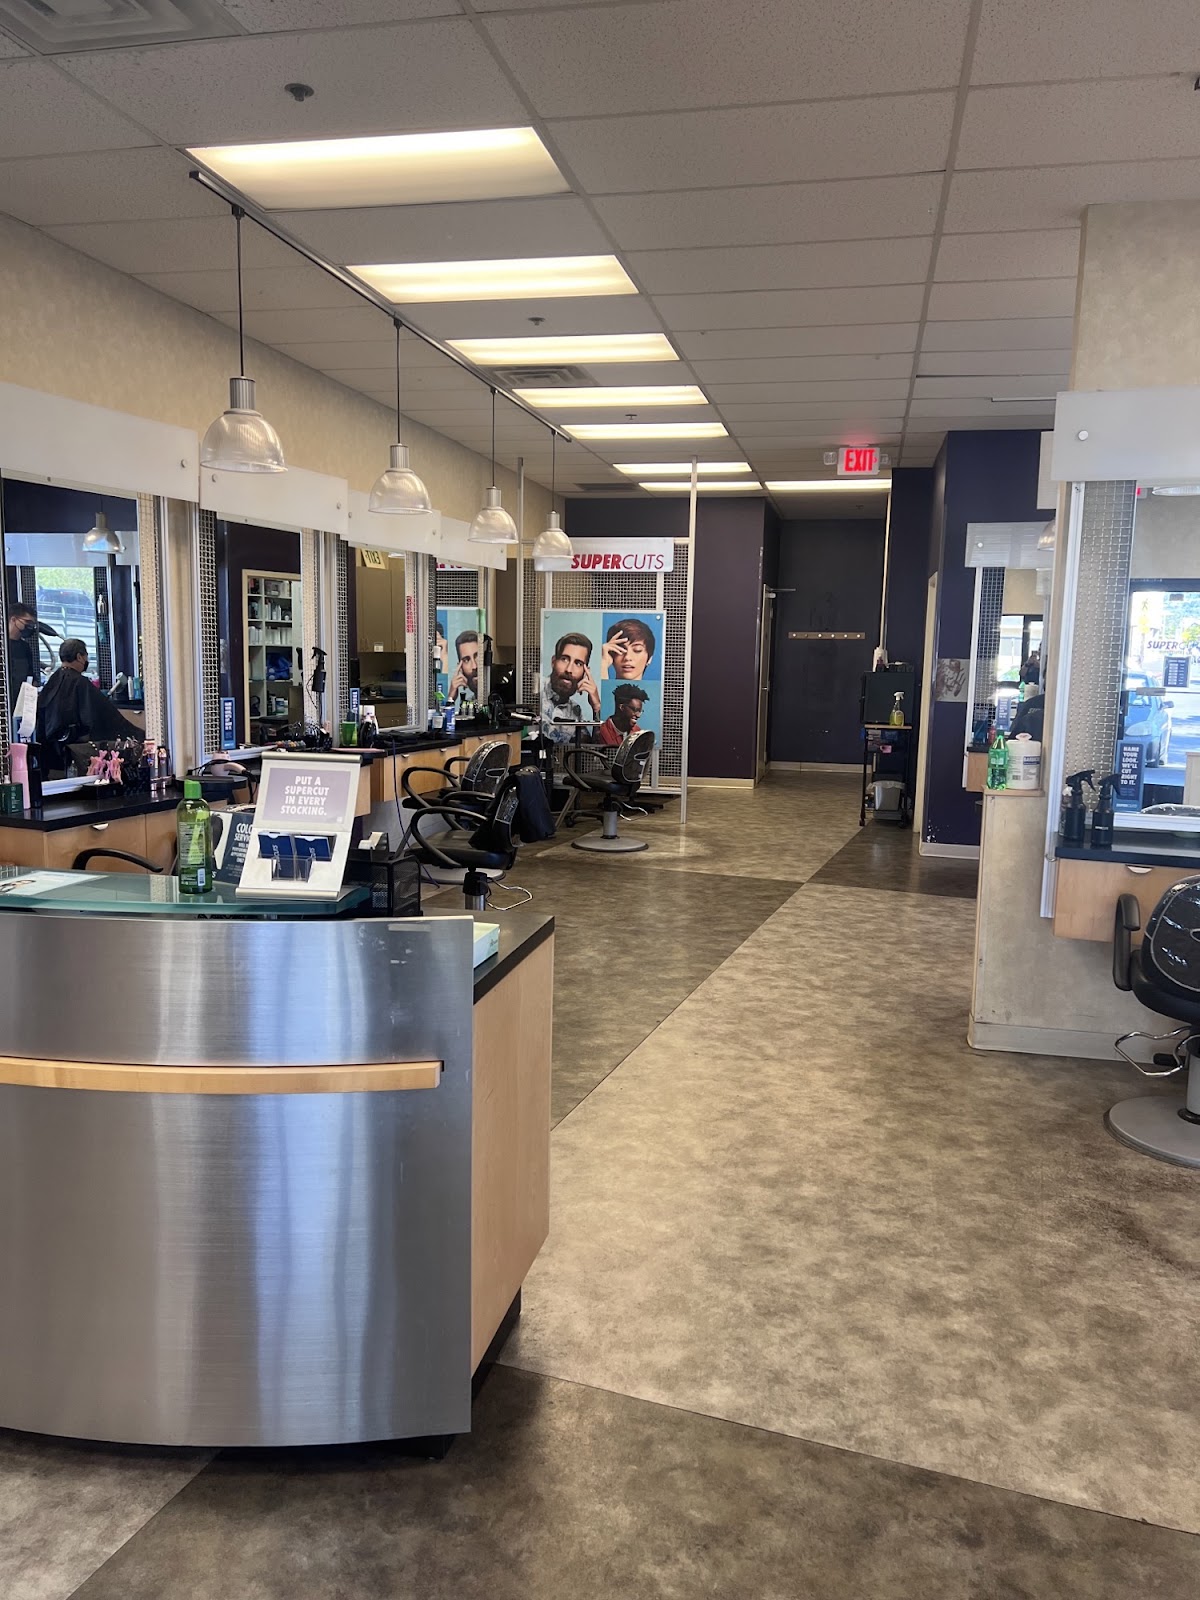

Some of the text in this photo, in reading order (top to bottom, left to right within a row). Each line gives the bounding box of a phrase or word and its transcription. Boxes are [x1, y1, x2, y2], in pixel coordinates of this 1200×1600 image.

[844, 448, 875, 471] EXIT
[570, 553, 665, 570] SUPERCUTS
[294, 775, 322, 786] PUT A
[284, 785, 330, 796] SUPERCUT
[284, 795, 327, 806] IN EVERY
[280, 805, 328, 816] STOCKING.
